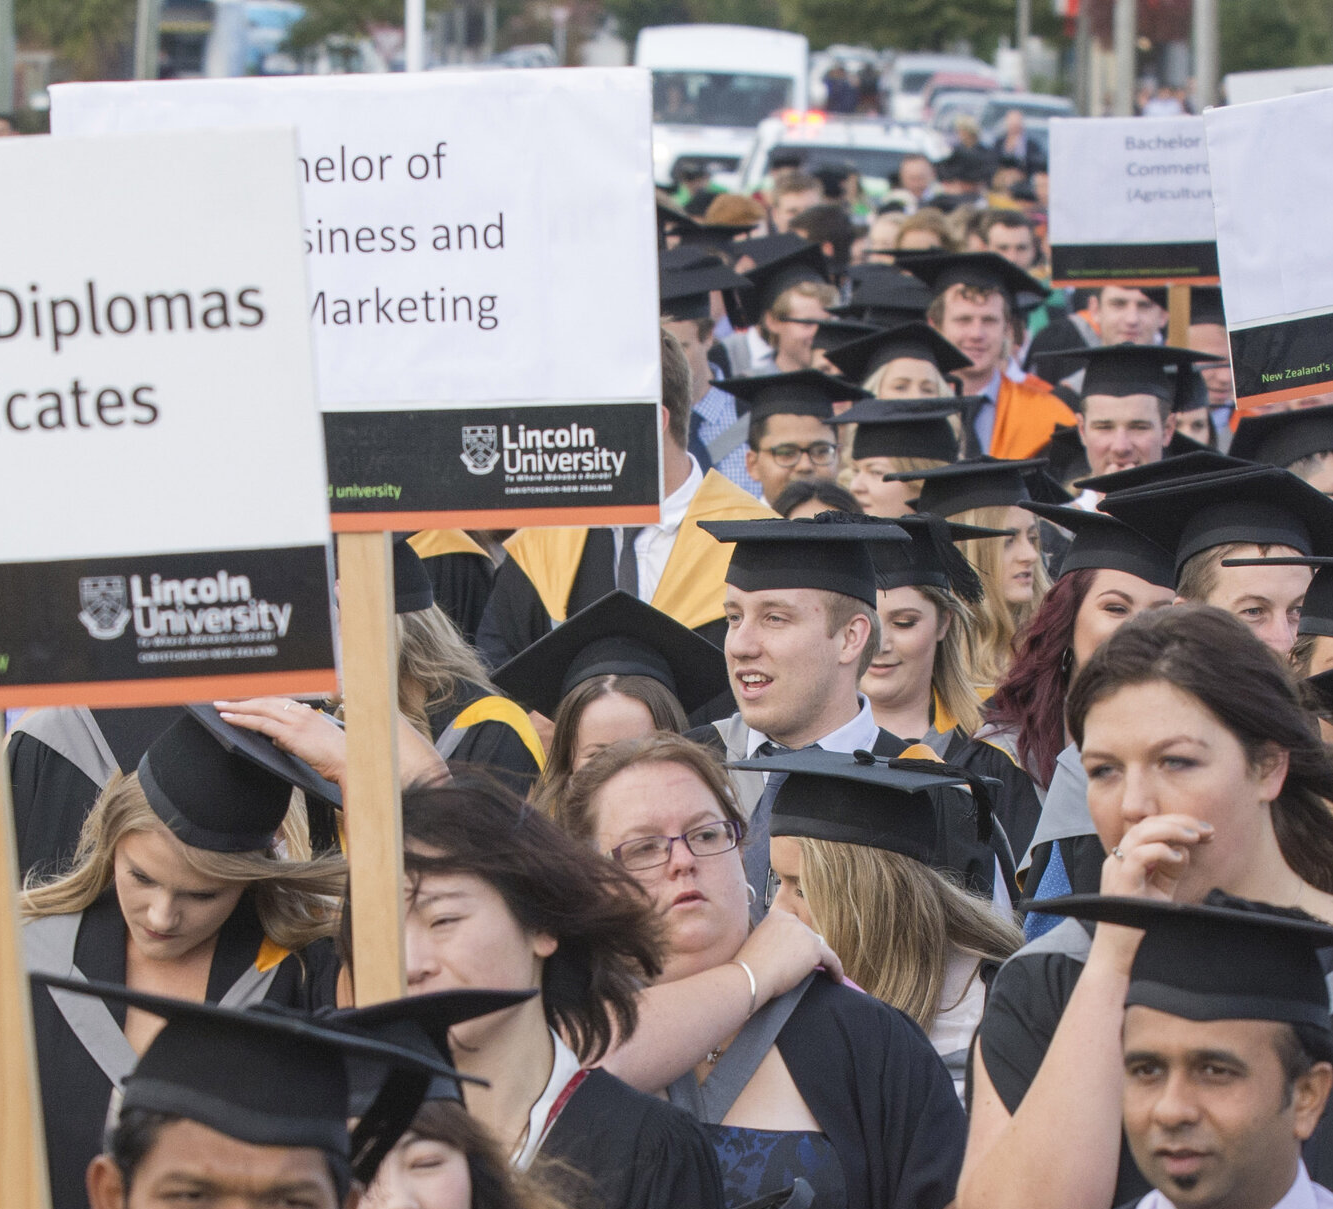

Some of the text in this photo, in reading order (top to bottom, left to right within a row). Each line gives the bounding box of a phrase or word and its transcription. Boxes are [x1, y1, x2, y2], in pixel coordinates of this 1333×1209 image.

[1125, 136, 1201, 150] Bachelor
[407, 141, 447, 180] of
[1127, 162, 1210, 176] Commerc
[432, 212, 504, 251] and
[1262, 372, 1283, 383] New
[1285, 363, 1331, 378] Zealand's
[502, 423, 595, 449] Lincoln
[503, 446, 626, 476] University
[335, 482, 402, 500] university
[130, 570, 252, 607] Lincoln
[133, 598, 292, 637] University
